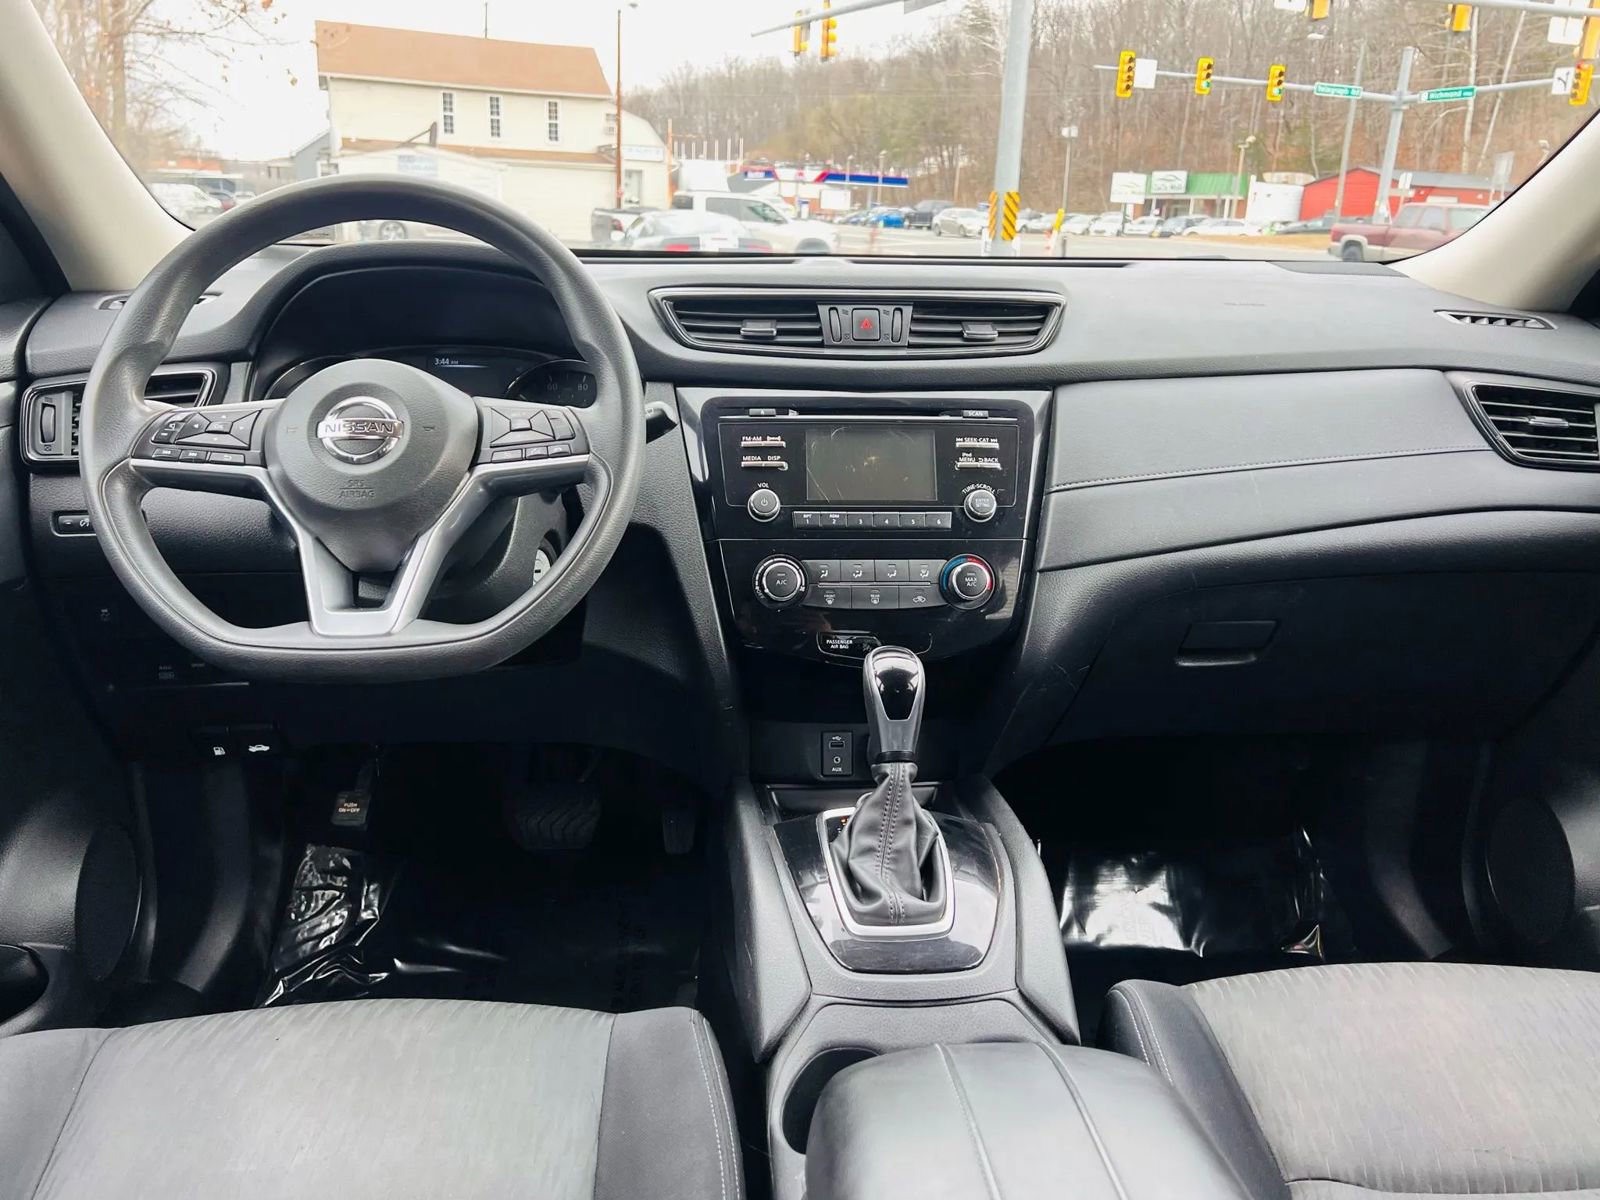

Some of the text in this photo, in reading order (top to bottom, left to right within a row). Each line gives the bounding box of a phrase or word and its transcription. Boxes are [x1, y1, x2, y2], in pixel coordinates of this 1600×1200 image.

[434, 357, 450, 366] 3:44
[577, 383, 589, 391] 80
[324, 421, 394, 434] NISSAN
